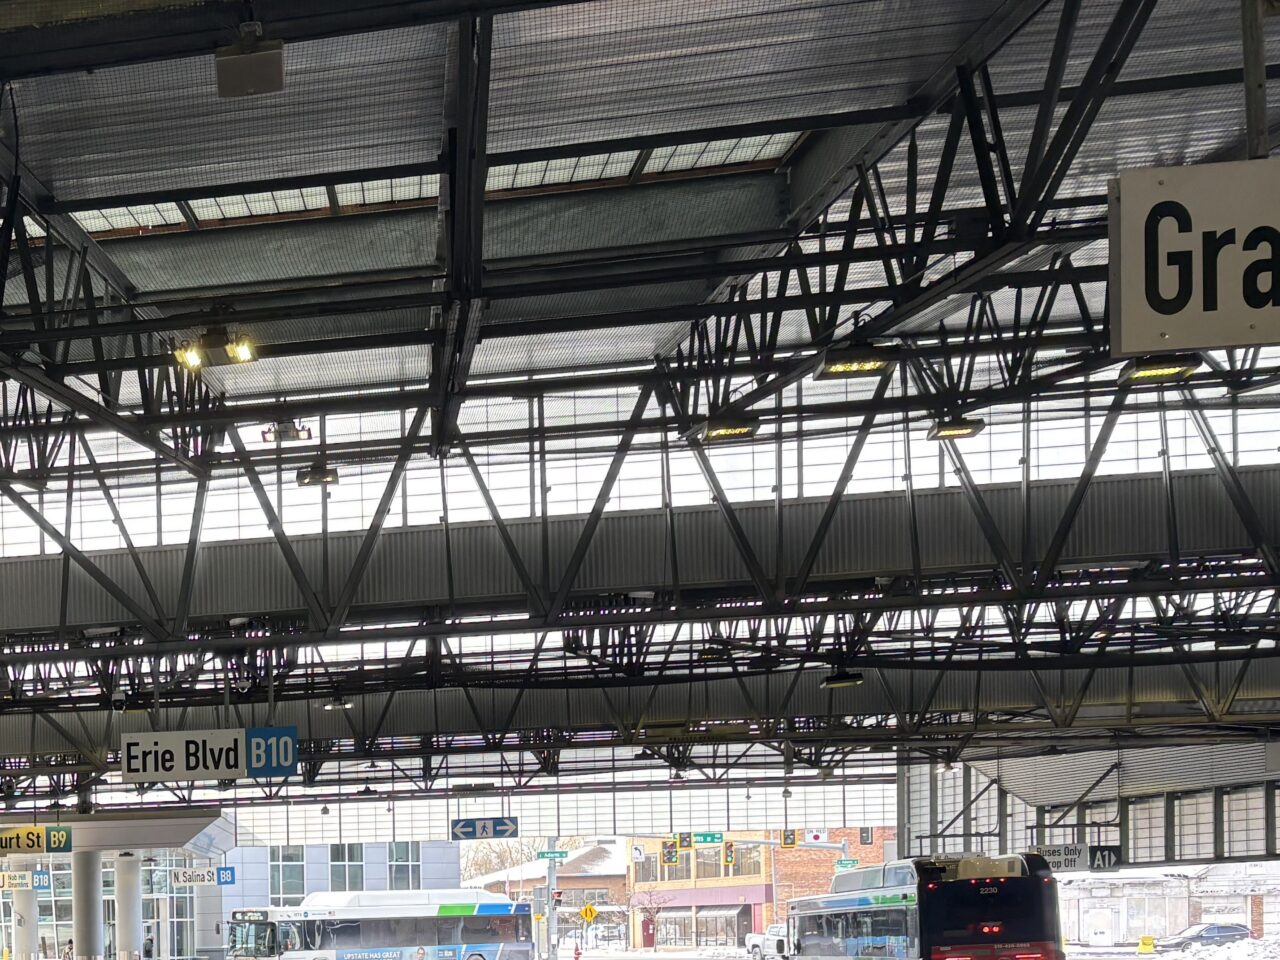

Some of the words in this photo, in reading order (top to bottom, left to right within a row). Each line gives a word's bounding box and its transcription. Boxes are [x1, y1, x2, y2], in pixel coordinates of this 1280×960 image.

[1145, 200, 1280, 315] Gra
[126, 741, 175, 773] Erie
[185, 738, 239, 771] Blvd
[251, 736, 293, 768] B10
[26, 831, 42, 848] St
[50, 831, 67, 848] B9
[1063, 846, 1082, 858] Only
[1093, 850, 1110, 868] A1
[1048, 860, 1062, 869] rop
[1064, 858, 1078, 868] Off
[33, 874, 49, 887] B18
[173, 872, 182, 883] N.
[182, 871, 206, 883] Salina
[206, 870, 215, 882] St
[219, 870, 232, 882] B8
